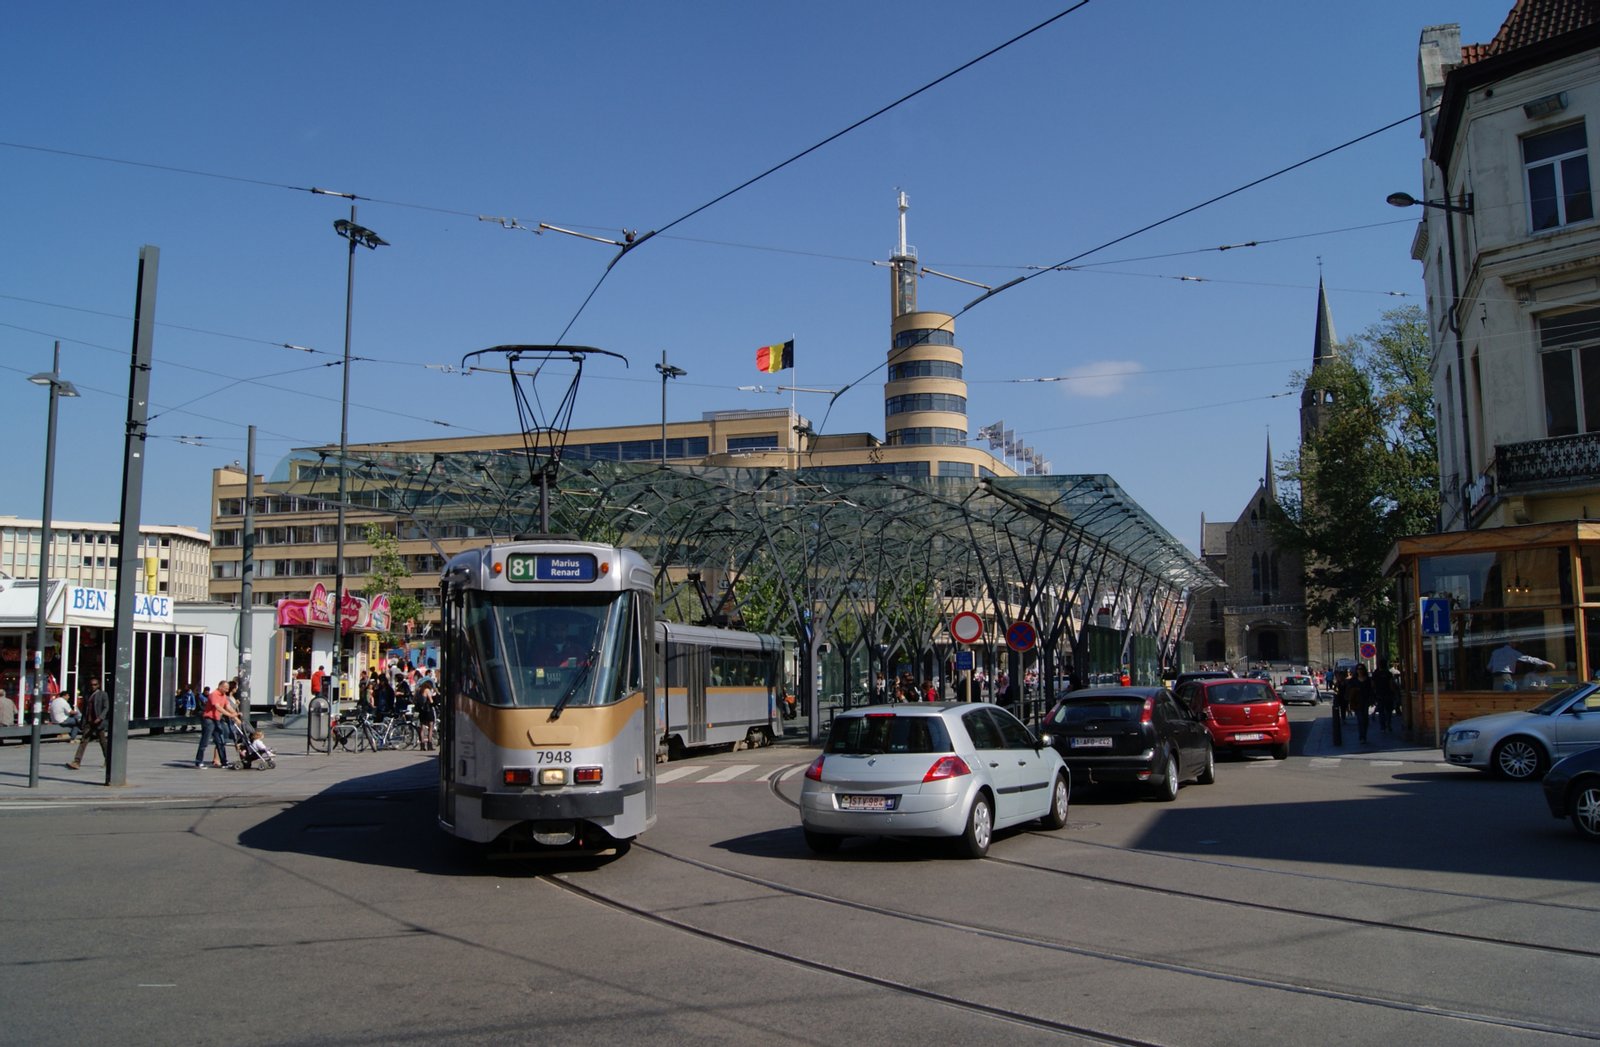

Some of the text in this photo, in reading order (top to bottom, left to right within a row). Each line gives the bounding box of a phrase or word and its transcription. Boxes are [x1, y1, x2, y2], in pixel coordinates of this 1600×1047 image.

[512, 559, 534, 576] 81
[73, 588, 168, 616] BEN LACE
[536, 751, 572, 764] 7948
